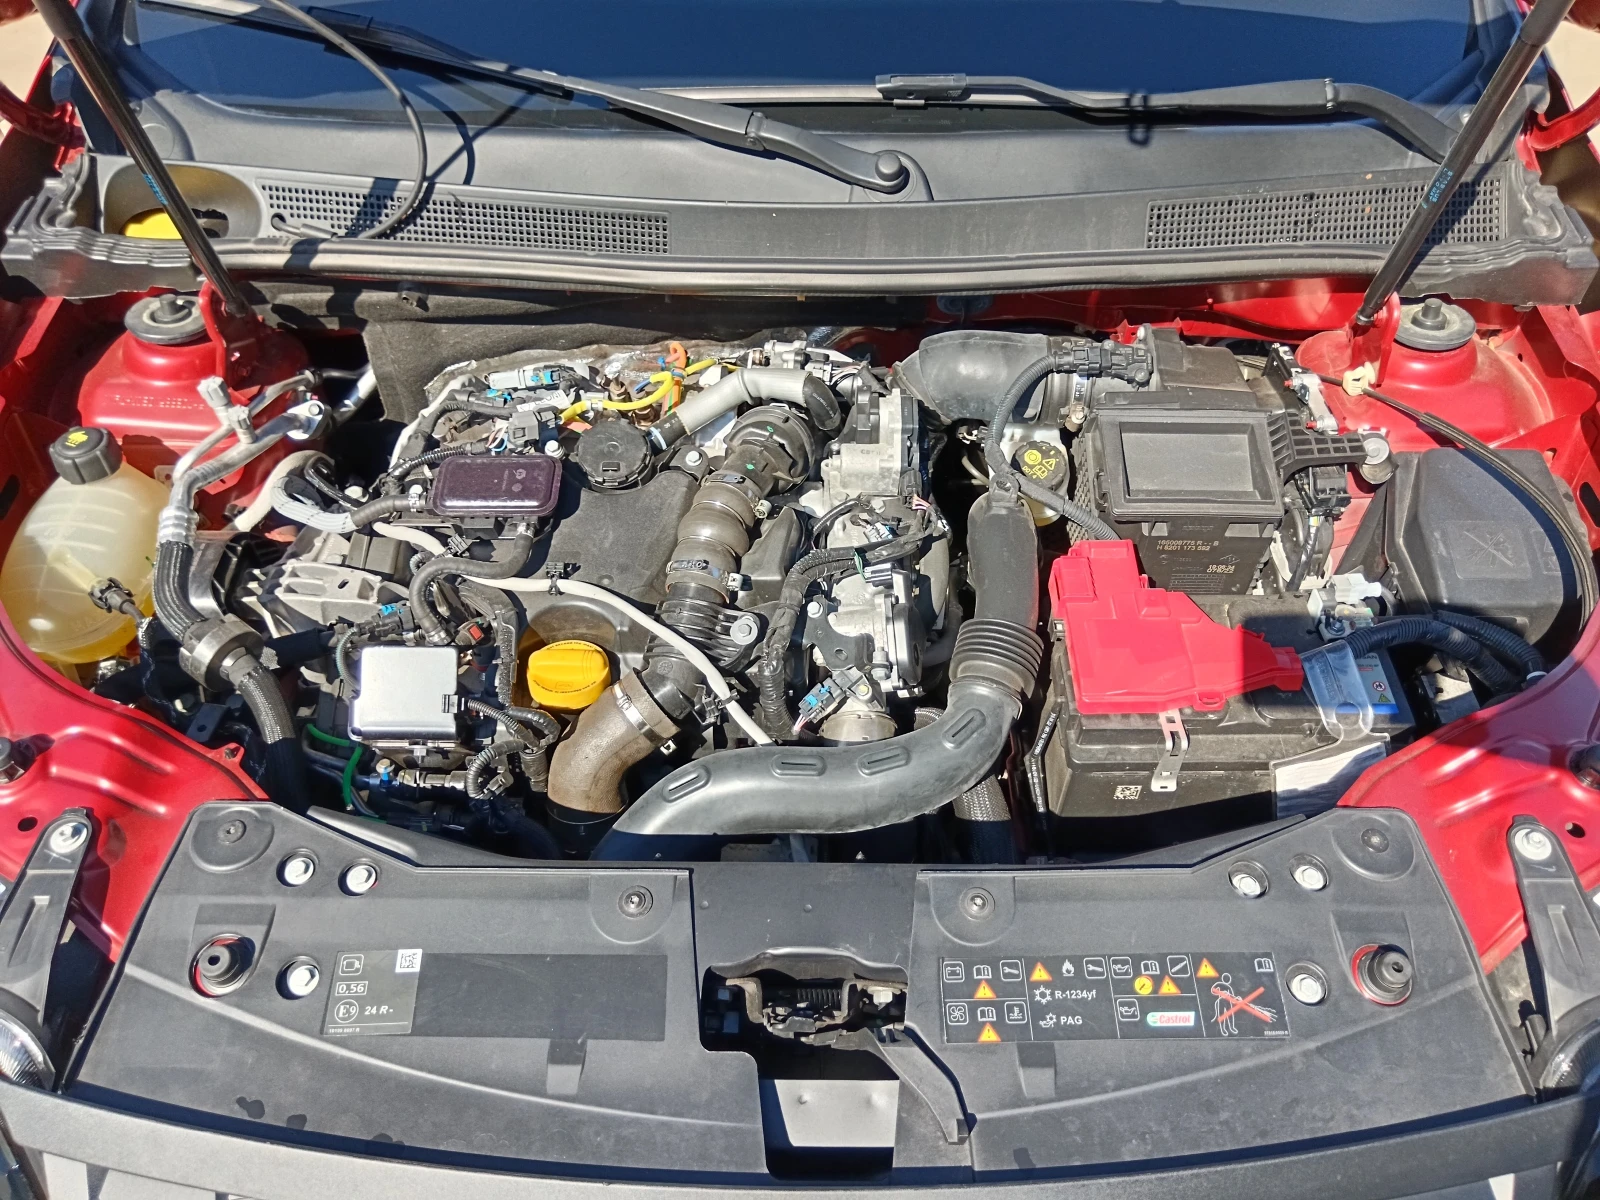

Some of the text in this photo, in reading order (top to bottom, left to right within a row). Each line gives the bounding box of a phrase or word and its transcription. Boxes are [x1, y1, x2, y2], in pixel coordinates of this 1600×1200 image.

[1021, 465, 1034, 475] DOT
[338, 983, 365, 994] 0,56
[1054, 989, 1097, 1000] R-1234yf
[364, 1005, 377, 1015] 24
[1060, 1015, 1083, 1025] PAG
[1159, 1014, 1191, 1025] Castrol
